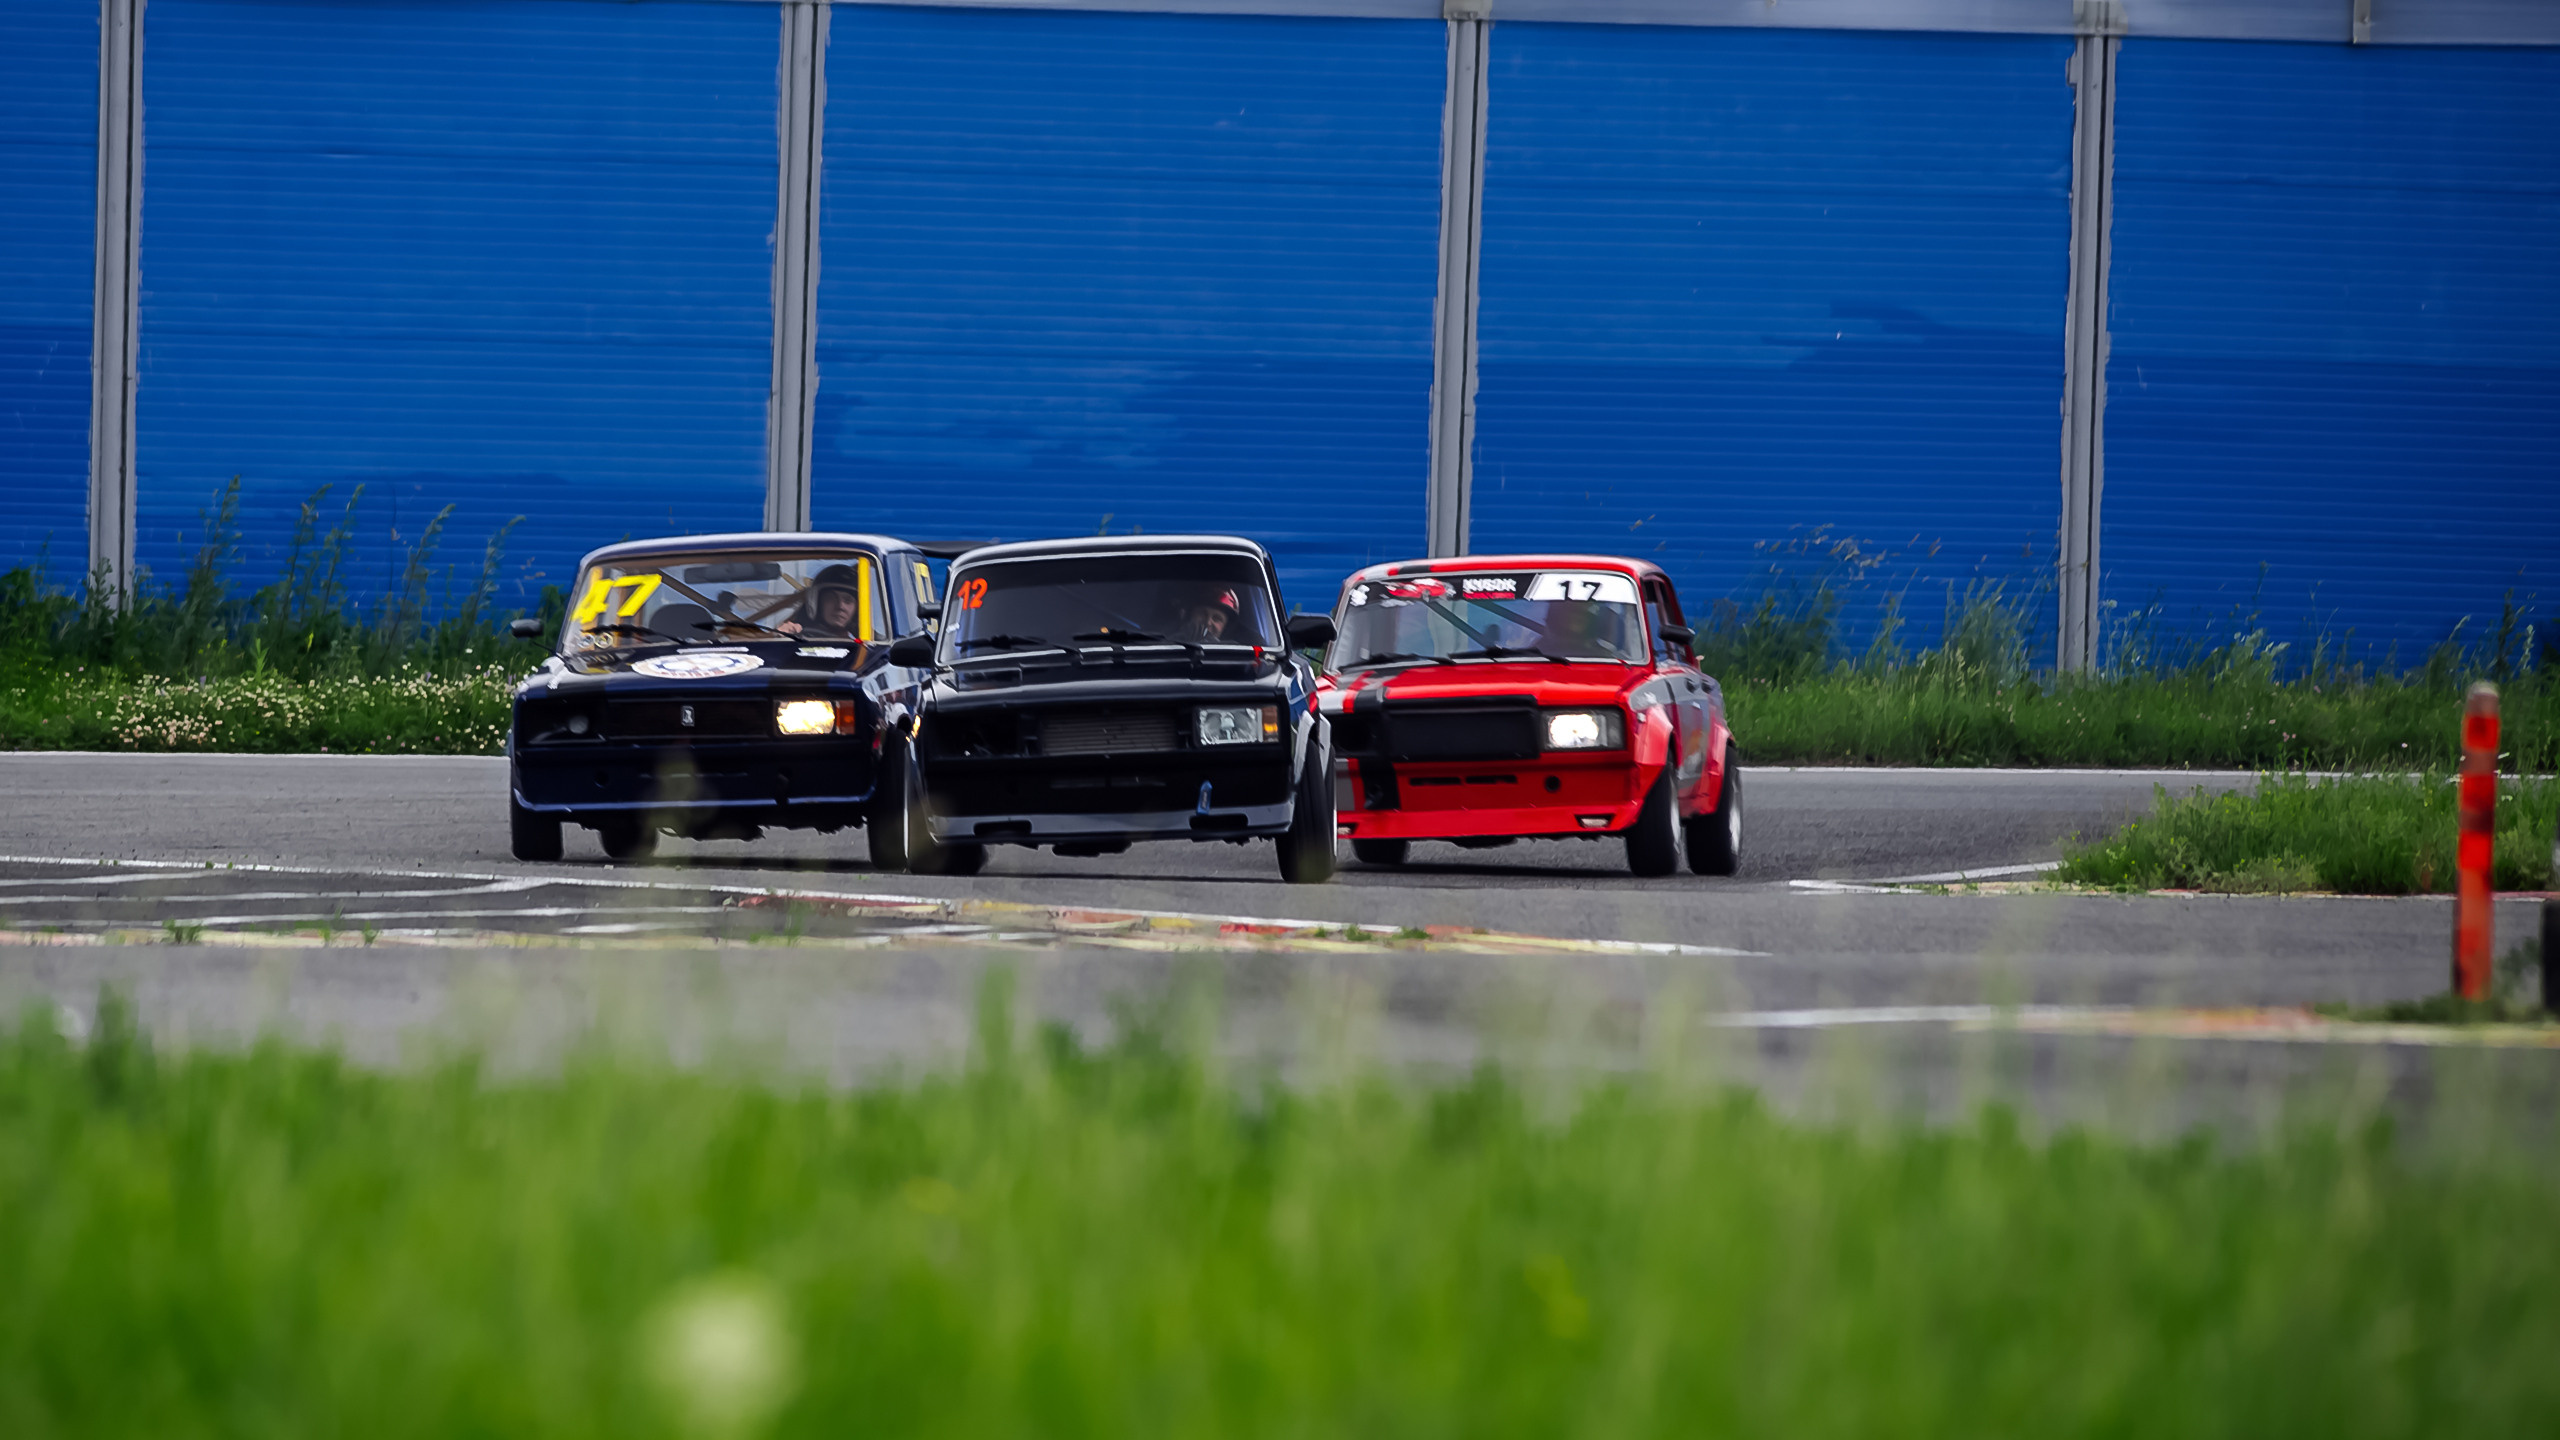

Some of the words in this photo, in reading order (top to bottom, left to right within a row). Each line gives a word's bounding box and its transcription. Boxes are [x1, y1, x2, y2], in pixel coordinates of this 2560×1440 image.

[571, 574, 662, 624] 47
[957, 578, 988, 610] 12
[1560, 580, 1602, 601] 17
